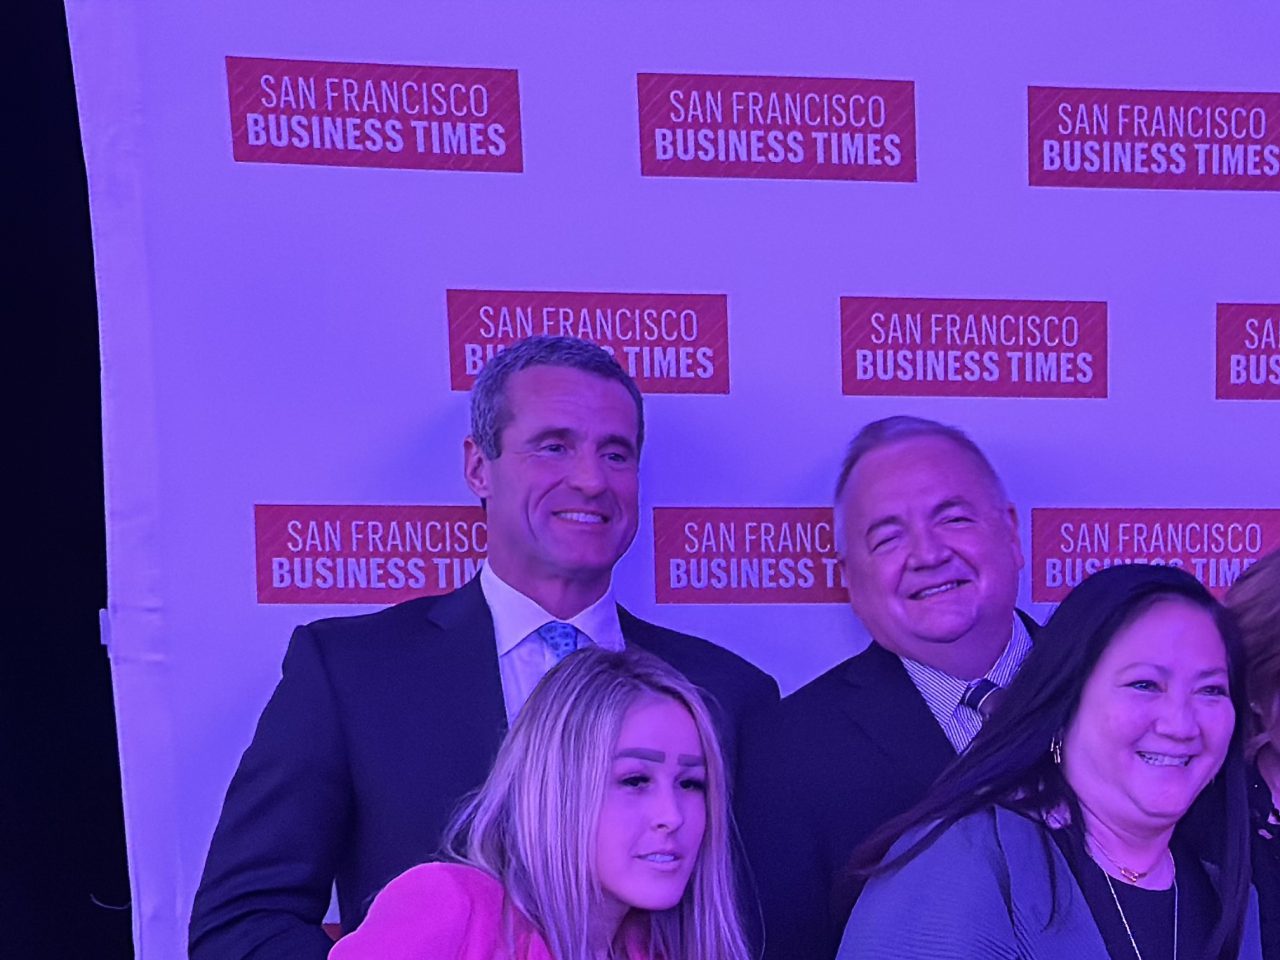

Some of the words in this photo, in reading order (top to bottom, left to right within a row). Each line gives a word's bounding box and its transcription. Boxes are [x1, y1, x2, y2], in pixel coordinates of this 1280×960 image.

[261, 75, 316, 110] SAN
[326, 77, 488, 117] FRANCISCO
[670, 90, 722, 123] SAN
[732, 91, 885, 128] FRANCISCO
[247, 113, 404, 152] BUSINESS
[411, 120, 506, 156] TIMES
[1058, 103, 1108, 136] SAN
[1118, 105, 1266, 139] FRANCISCO
[655, 128, 804, 163] BUSINESS
[811, 131, 901, 166] TIMES
[1043, 139, 1186, 175] BUSINESS
[1194, 143, 1280, 176] TIMES
[479, 305, 533, 338] SAN
[542, 307, 698, 341] FRANCISCO
[871, 312, 921, 345] SAN
[931, 313, 1079, 347] FRANCISCO
[623, 347, 714, 379] TIMES
[856, 349, 1000, 382] BUSINESS
[1006, 351, 1093, 383] TIMES
[287, 520, 341, 552] SAN
[352, 521, 488, 553] FRANCISC
[684, 522, 734, 553] SAN
[745, 522, 837, 553] FRANC
[1060, 523, 1109, 554] SAN
[1118, 523, 1262, 553] FRANCISCO
[272, 557, 425, 589] BUSINESS
[431, 557, 486, 589] TIM
[670, 558, 815, 588] BUSINESS
[1191, 558, 1257, 588] TIM
